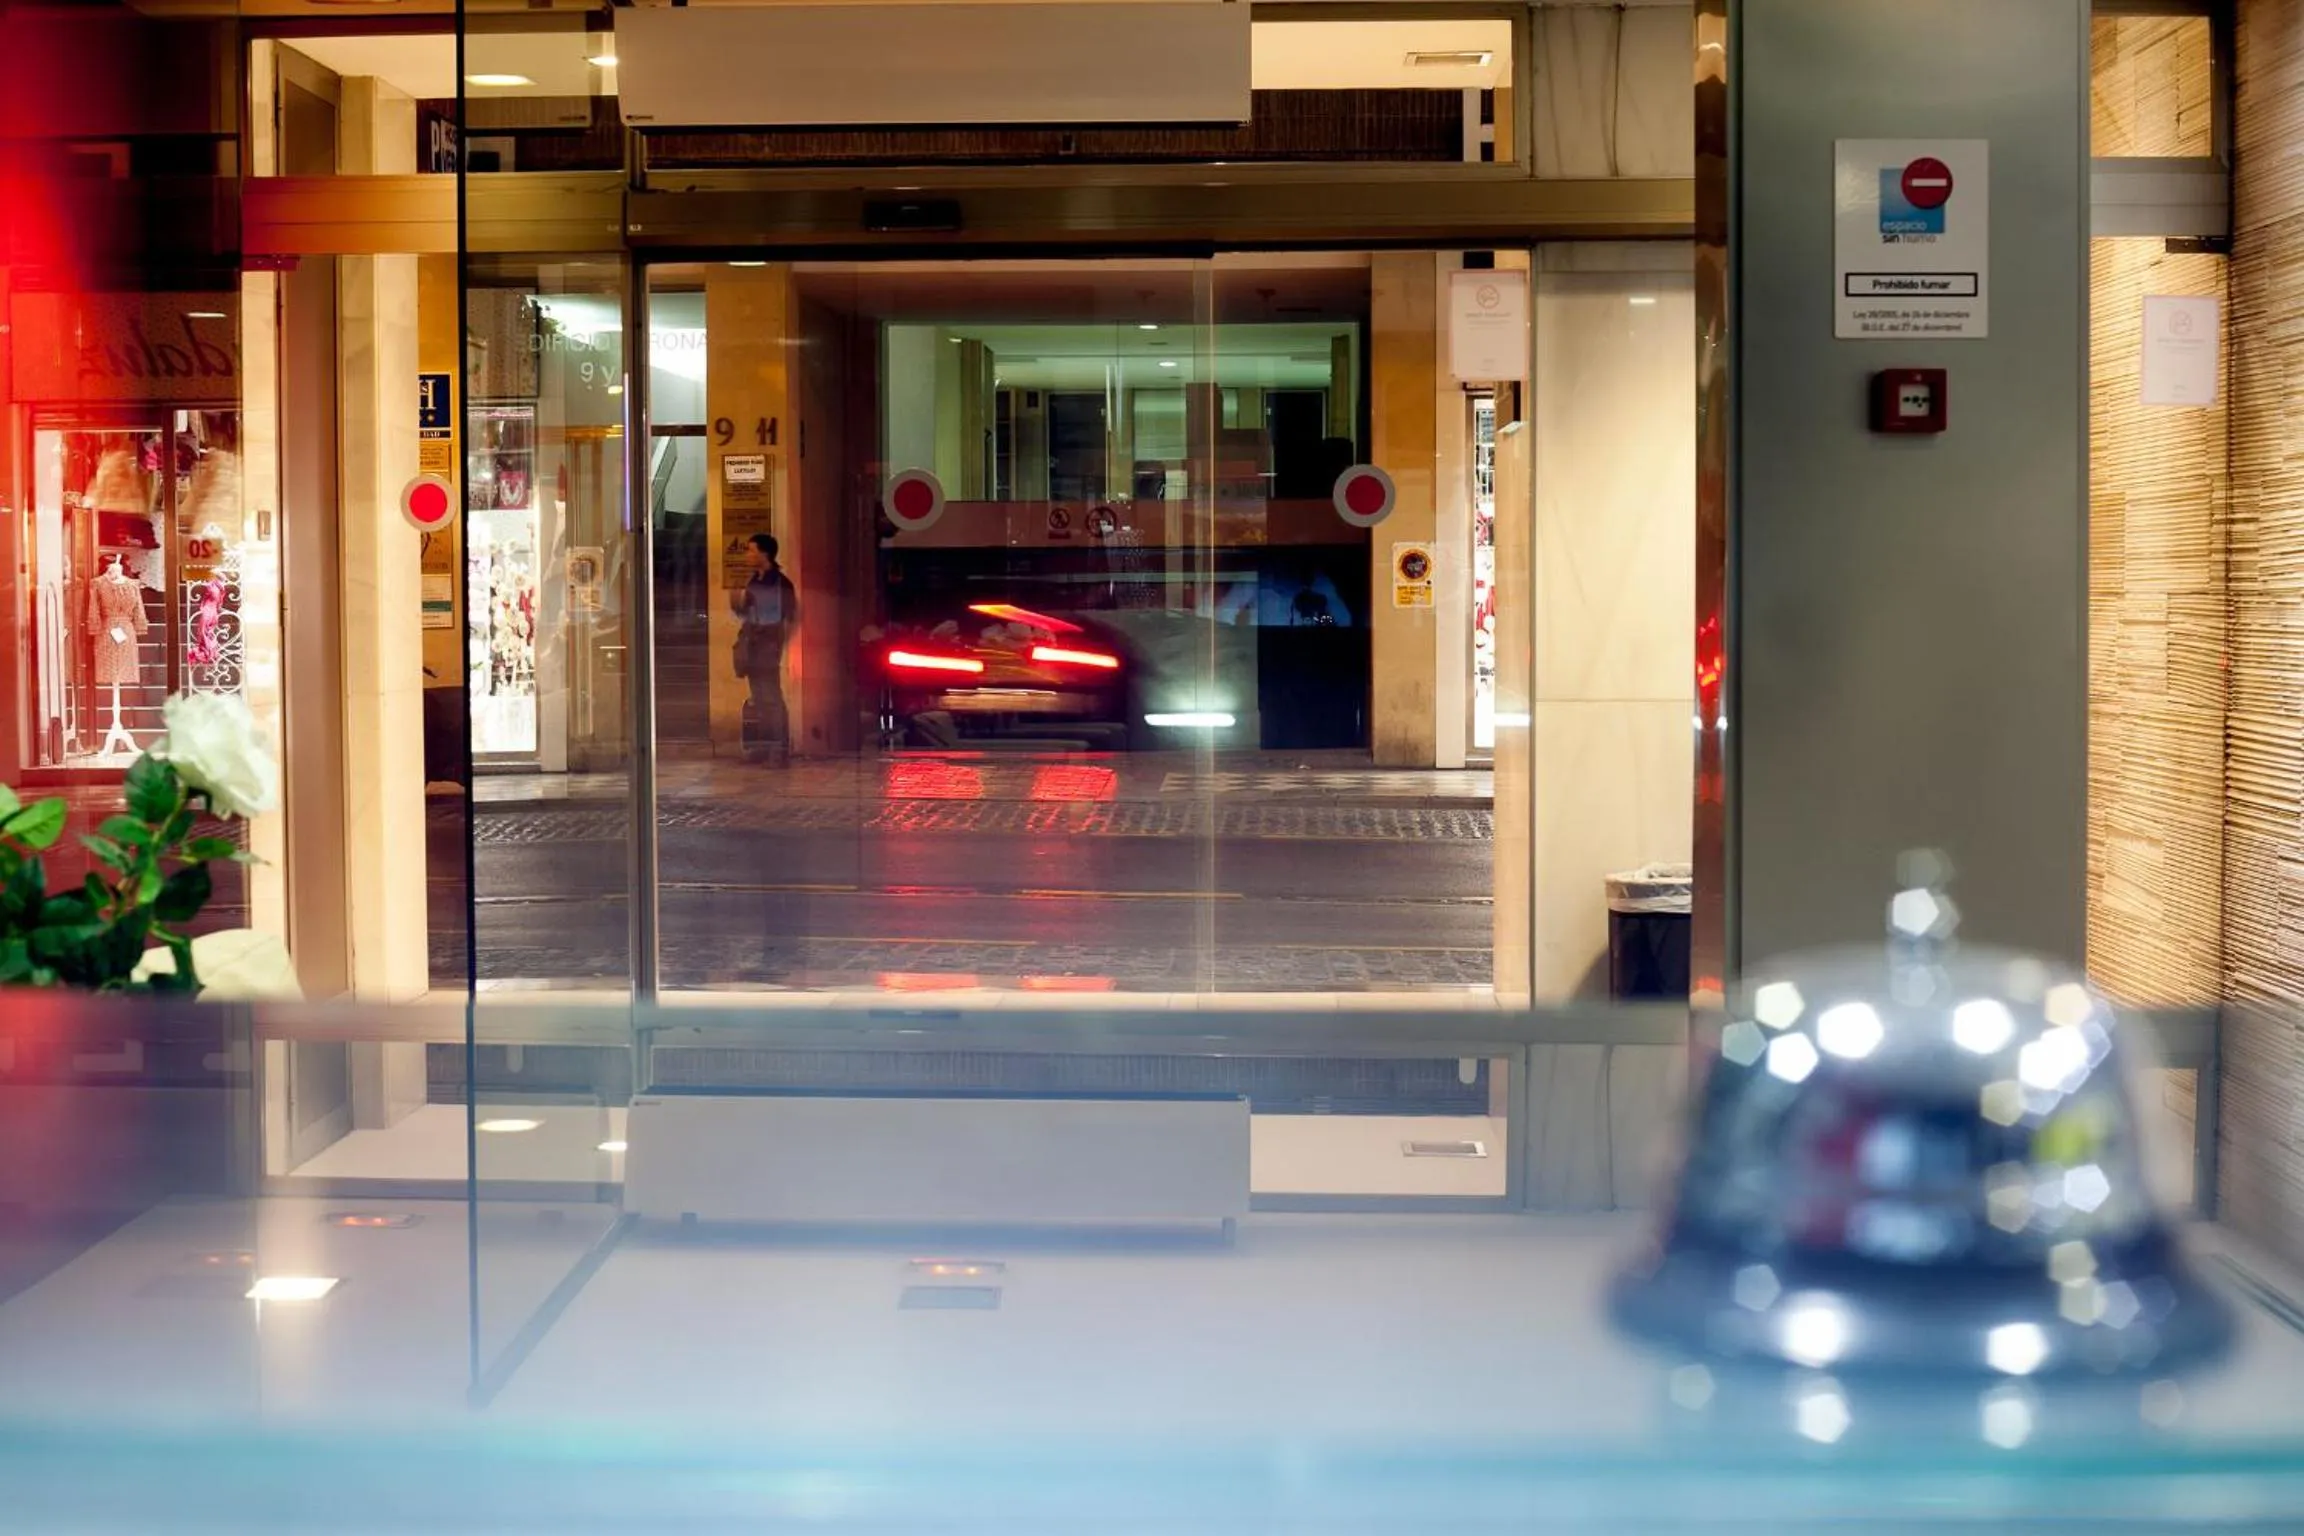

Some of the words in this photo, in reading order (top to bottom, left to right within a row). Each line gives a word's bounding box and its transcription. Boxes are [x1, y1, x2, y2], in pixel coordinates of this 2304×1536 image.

[1882, 233, 1900, 244] sin
[1872, 279, 1919, 290] Prohibido
[1920, 279, 1951, 290] fumar
[581, 361, 594, 382] 9
[715, 417, 735, 447] 9
[756, 417, 779, 446] 11
